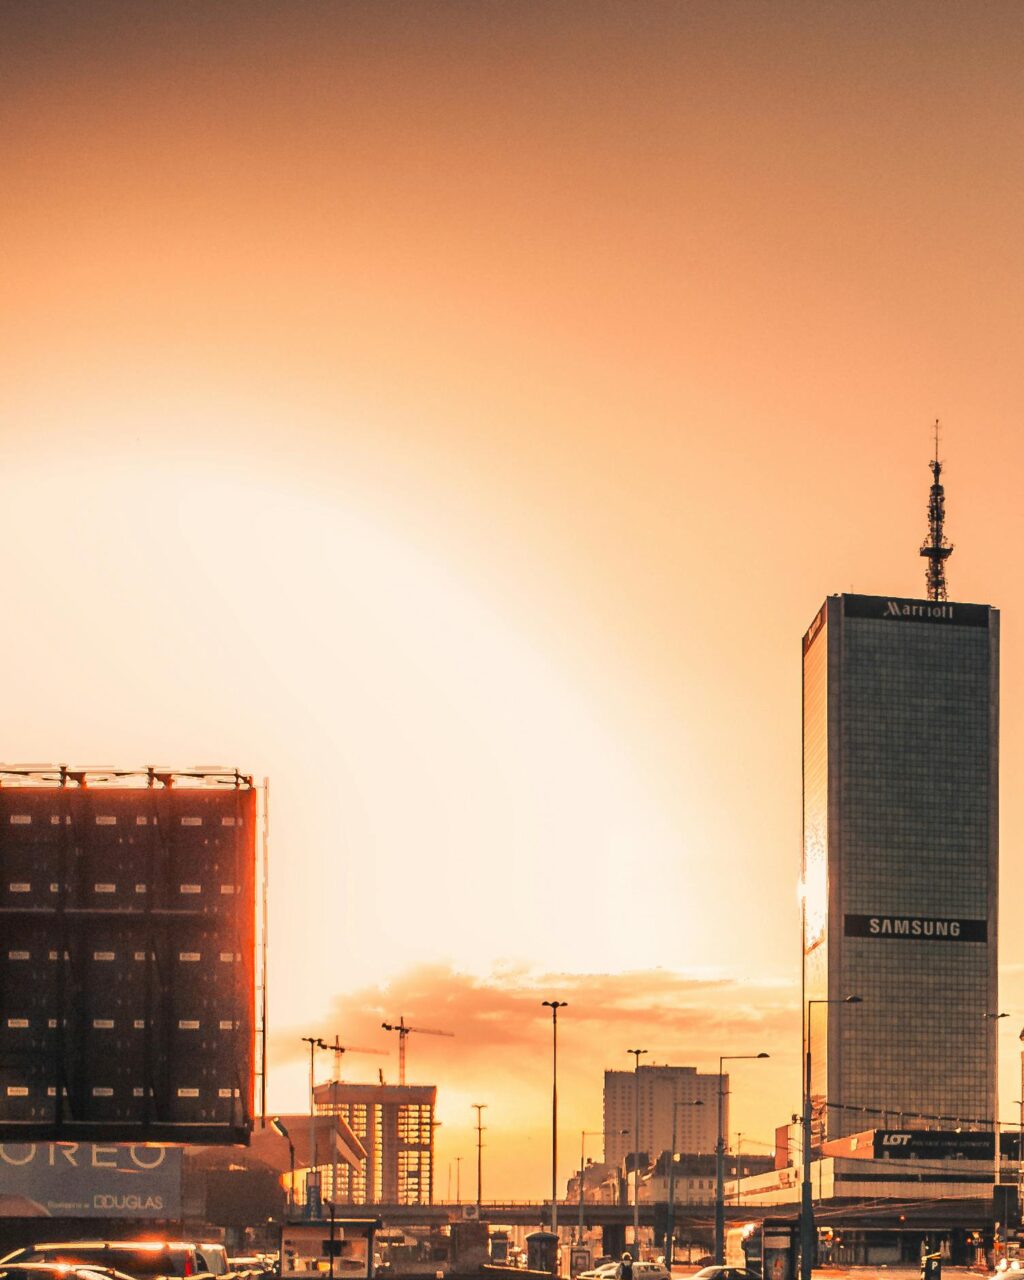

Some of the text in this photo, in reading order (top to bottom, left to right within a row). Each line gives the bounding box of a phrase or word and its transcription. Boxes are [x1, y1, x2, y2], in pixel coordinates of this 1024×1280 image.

[883, 601, 954, 619] Marriott
[869, 918, 961, 937] SAMSUNG
[882, 1134, 912, 1146] LOT
[93, 1194, 164, 1210] DOUGLAS
